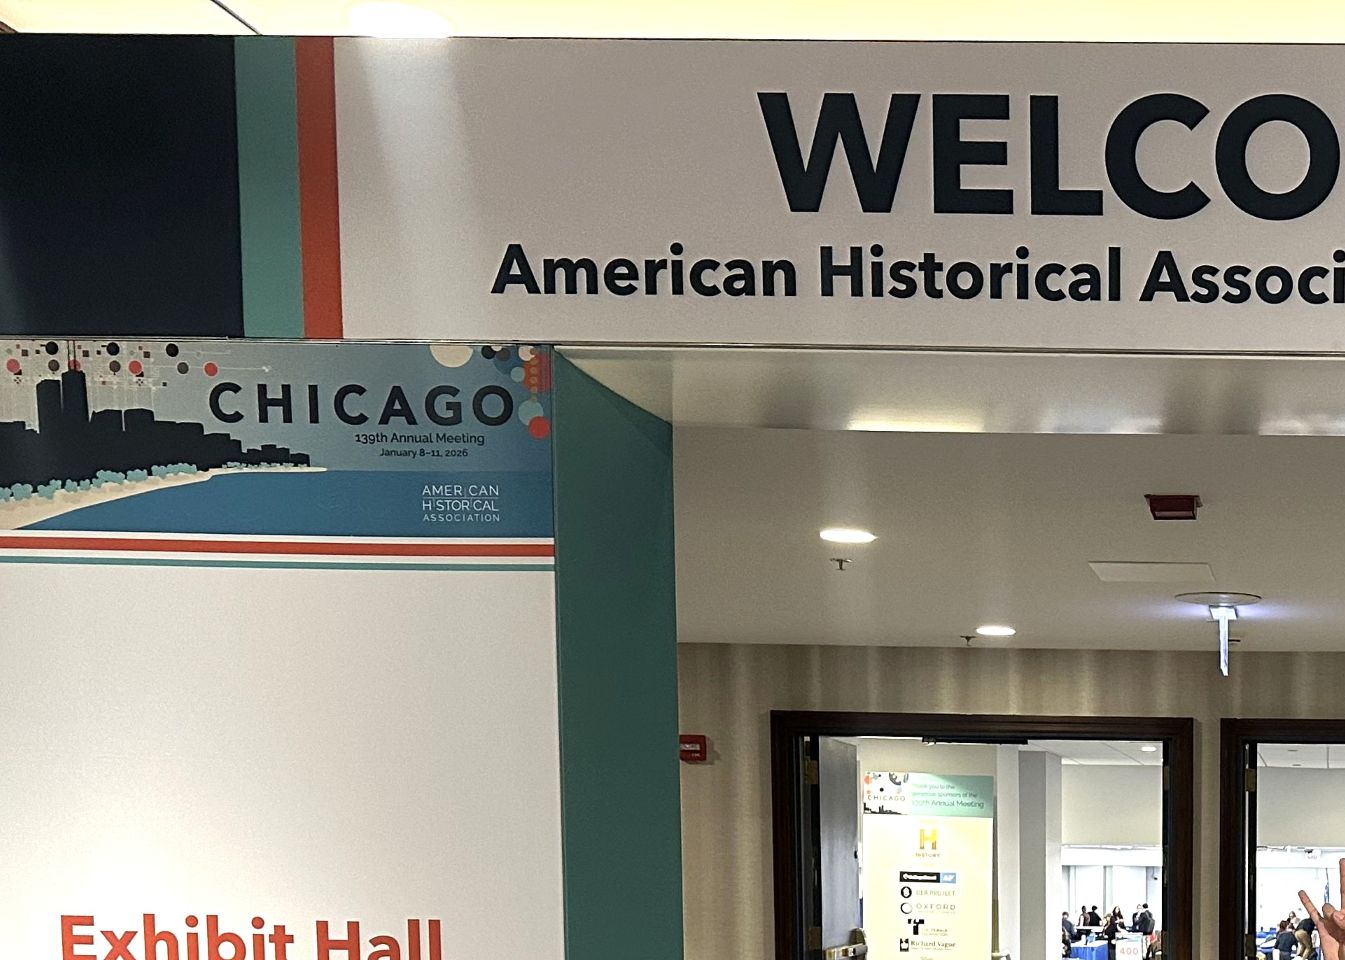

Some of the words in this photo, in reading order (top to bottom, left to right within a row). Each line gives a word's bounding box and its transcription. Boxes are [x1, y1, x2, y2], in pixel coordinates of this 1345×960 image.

[491, 243, 796, 296] American
[820, 244, 1120, 301] Historical
[208, 381, 515, 426] CHICAGO
[355, 432, 387, 444] 139th
[391, 433, 433, 443] Annual
[436, 433, 484, 446] Meeting
[380, 448, 417, 458] January
[445, 449, 468, 457] 2026
[423, 514, 500, 522] ASSOCIATION
